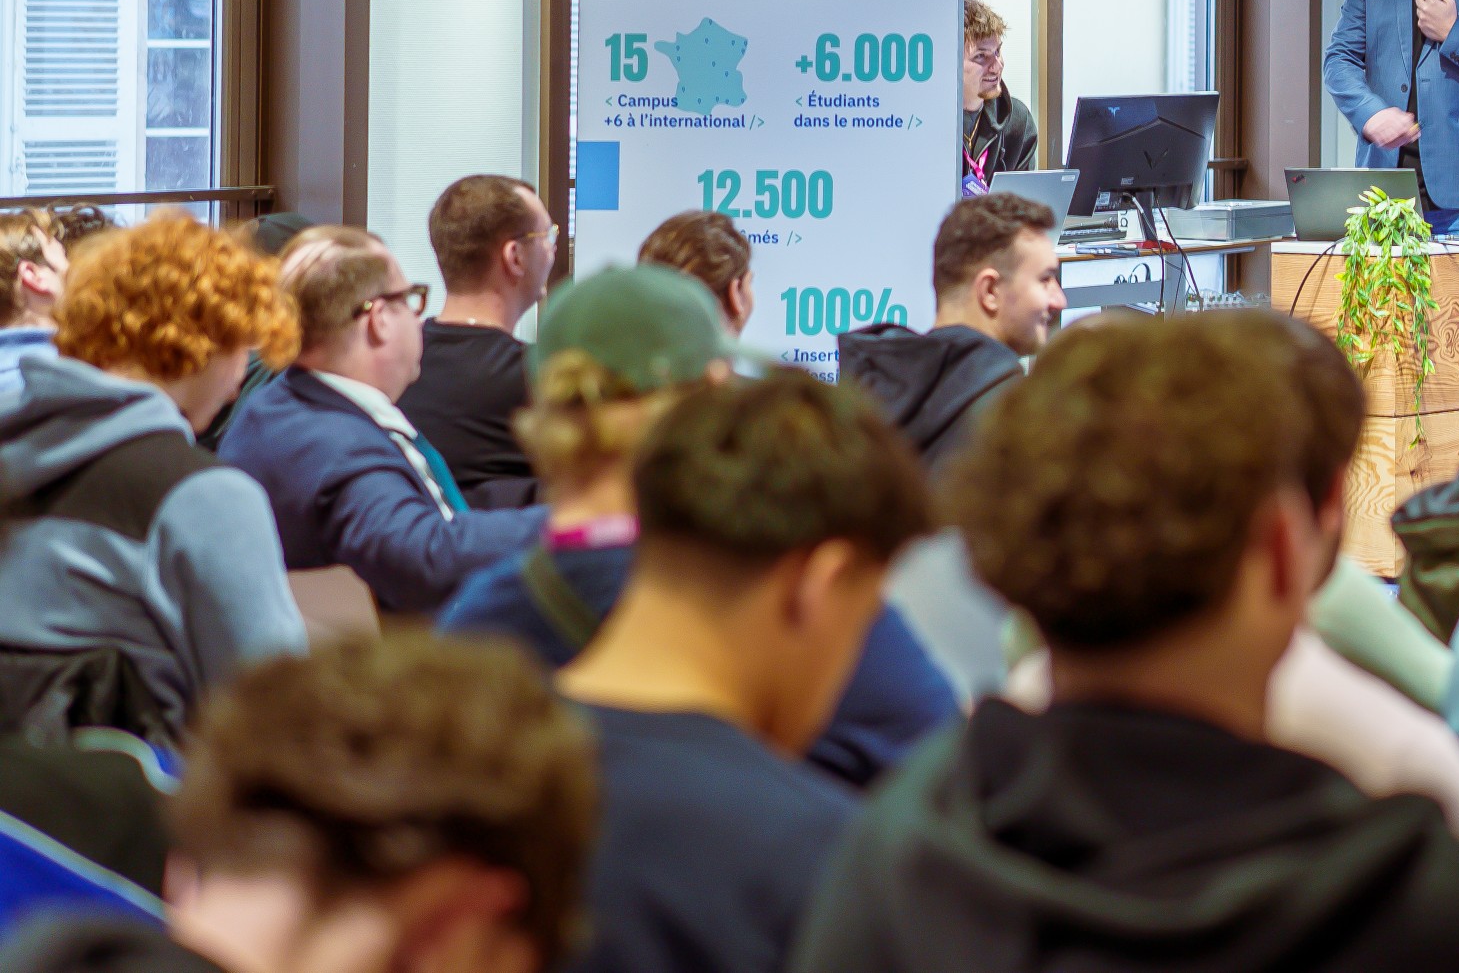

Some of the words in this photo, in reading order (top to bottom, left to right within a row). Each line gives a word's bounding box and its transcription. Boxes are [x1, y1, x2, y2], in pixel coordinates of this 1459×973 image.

[604, 33, 649, 82] 15
[795, 33, 934, 82] +6.000
[617, 94, 679, 110] Campus
[808, 89, 880, 108] Étudiants
[604, 114, 623, 128] +6
[627, 112, 636, 128] à
[794, 113, 830, 128] dans
[834, 113, 848, 128] le
[852, 113, 904, 128] monde
[697, 169, 834, 219] 12.500
[780, 287, 908, 337] 100%
[793, 348, 840, 362] Insert
